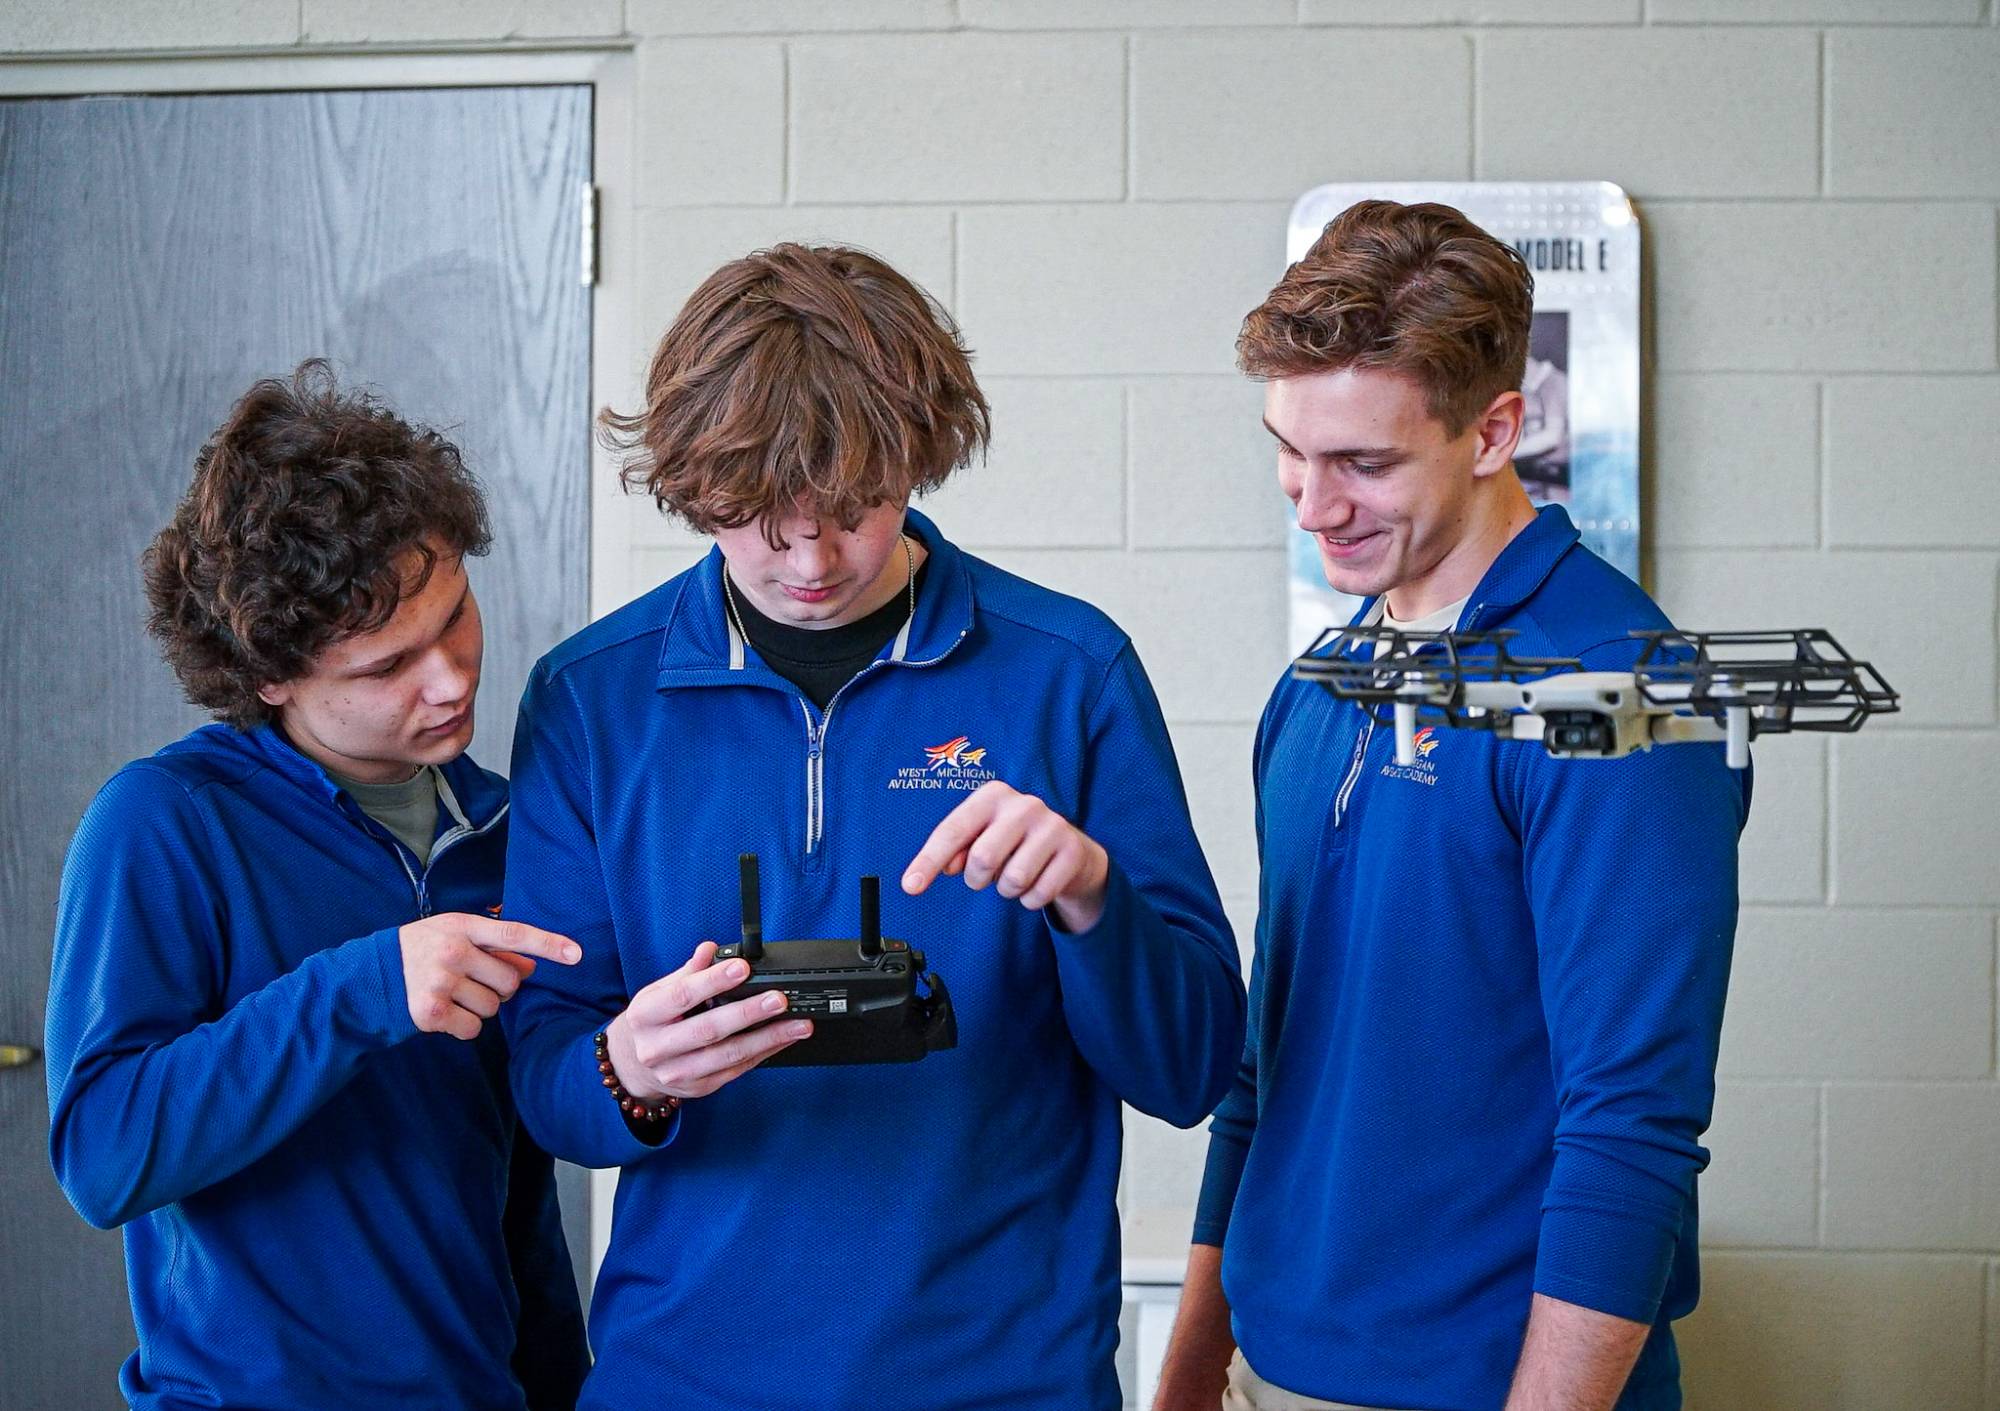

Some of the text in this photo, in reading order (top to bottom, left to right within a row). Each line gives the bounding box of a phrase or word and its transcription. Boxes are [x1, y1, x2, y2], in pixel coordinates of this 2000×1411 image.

[1599, 239, 1608, 271] E
[898, 768, 996, 779] WEST MICHIGAN
[888, 779, 984, 791] AVIATION ACAD
